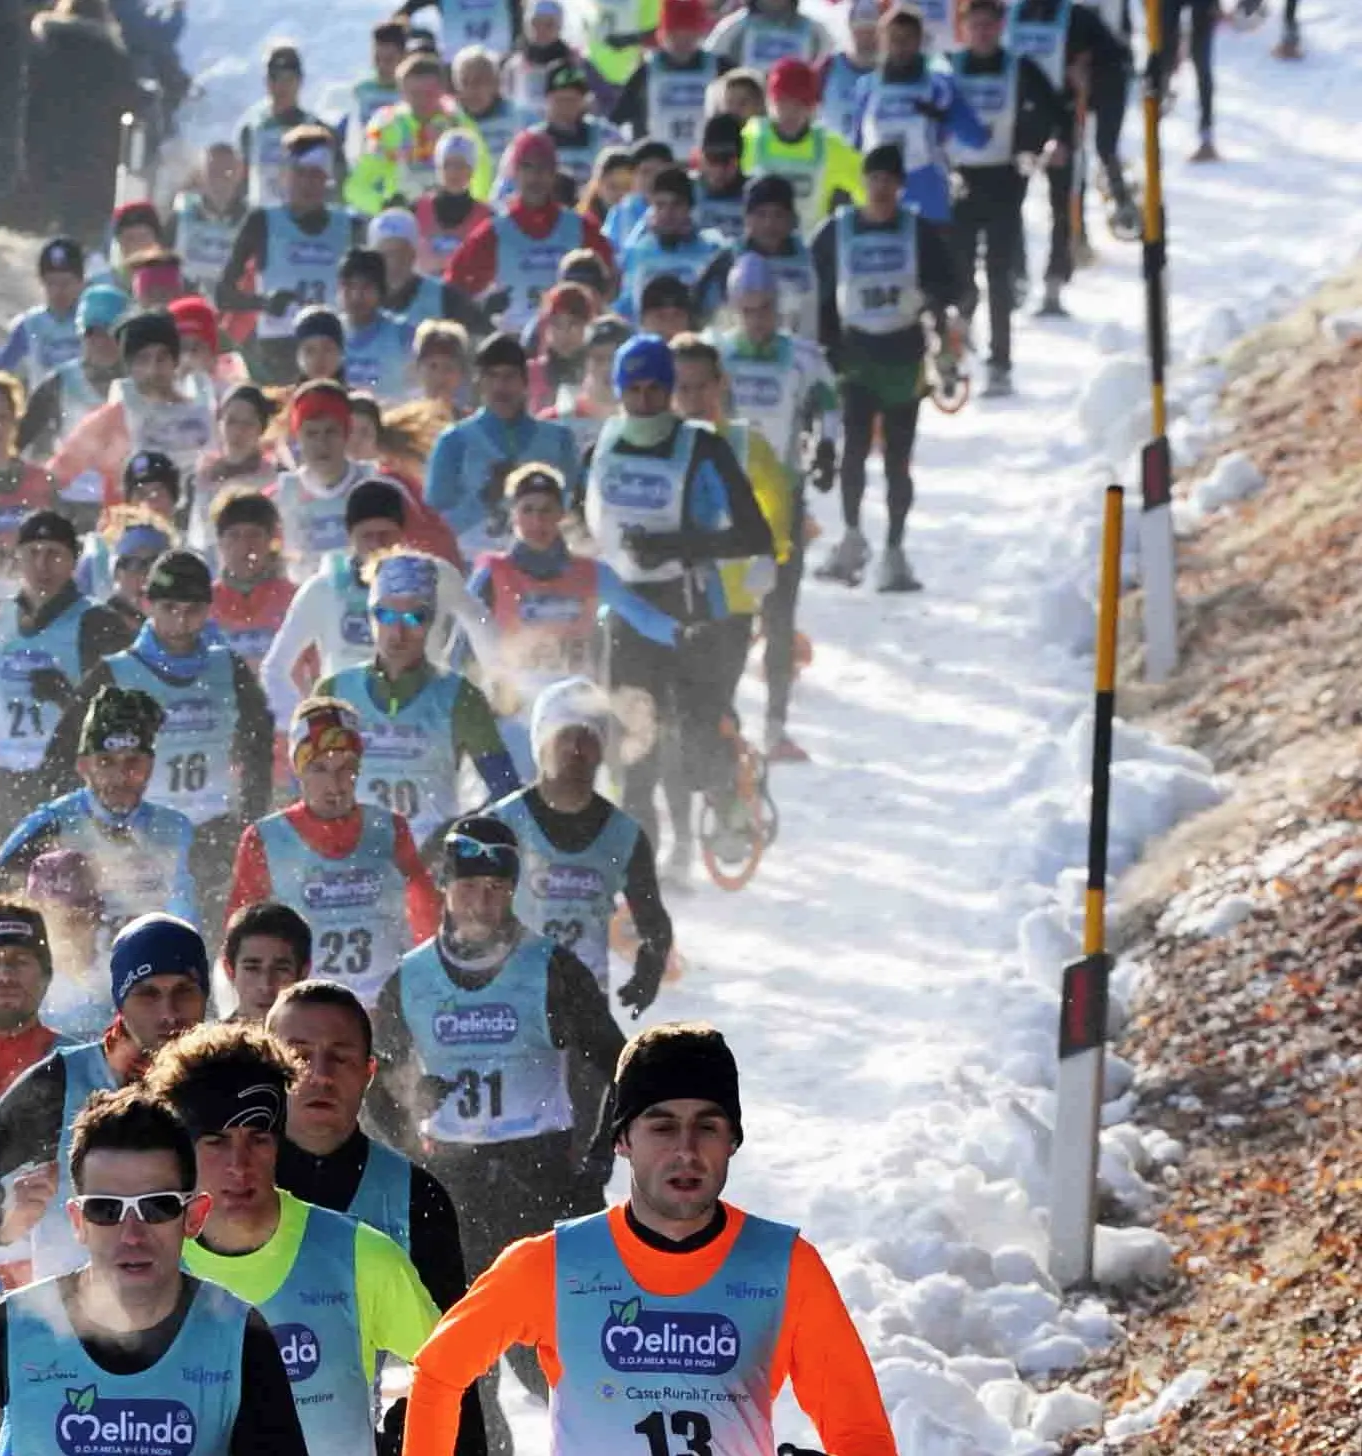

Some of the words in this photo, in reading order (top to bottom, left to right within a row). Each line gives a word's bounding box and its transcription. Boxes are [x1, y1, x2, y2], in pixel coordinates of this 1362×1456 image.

[166, 753, 207, 792] 16
[318, 928, 374, 974] 23
[435, 1008, 518, 1034] Melinda
[457, 1068, 503, 1119] 31
[606, 1322, 736, 1357] Melinda
[60, 1410, 192, 1444] Melinda
[634, 1410, 712, 1456] 13
